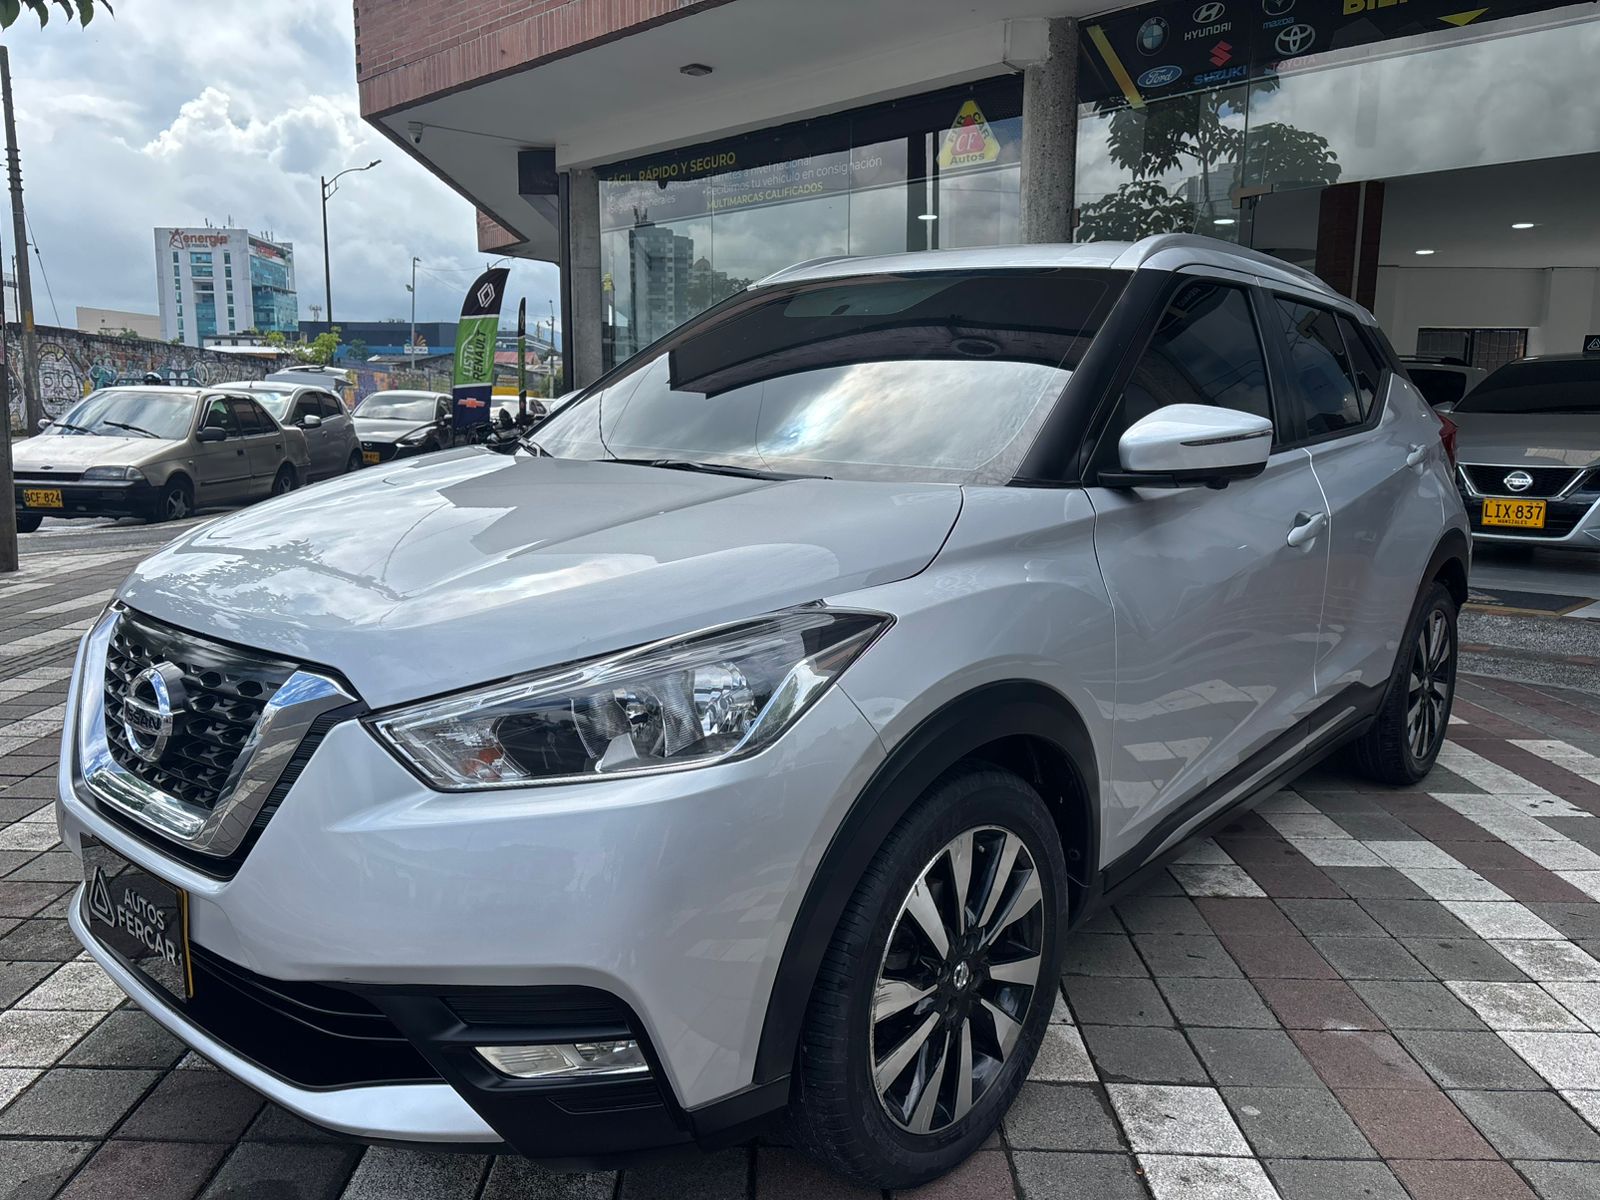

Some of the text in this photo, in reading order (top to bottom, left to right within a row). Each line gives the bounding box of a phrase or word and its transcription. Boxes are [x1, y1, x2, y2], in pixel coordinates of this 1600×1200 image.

[1184, 22, 1232, 41] HYUNDAI
[1271, 55, 1317, 71] TOYOTA
[1145, 69, 1175, 85] Ford
[639, 163, 679, 182] RÁPIDO
[680, 162, 688, 174] Y
[690, 152, 736, 173] SEGURO
[950, 153, 985, 165] Autos
[751, 178, 761, 189] tu
[803, 168, 815, 180] en
[706, 181, 823, 210] MULTIMARCAS CALIFICADOS
[473, 329, 486, 381] RENAULT
[1485, 503, 1543, 521] LIX 837
[124, 887, 166, 931] AUTOS
[117, 904, 176, 967] FERCAR
